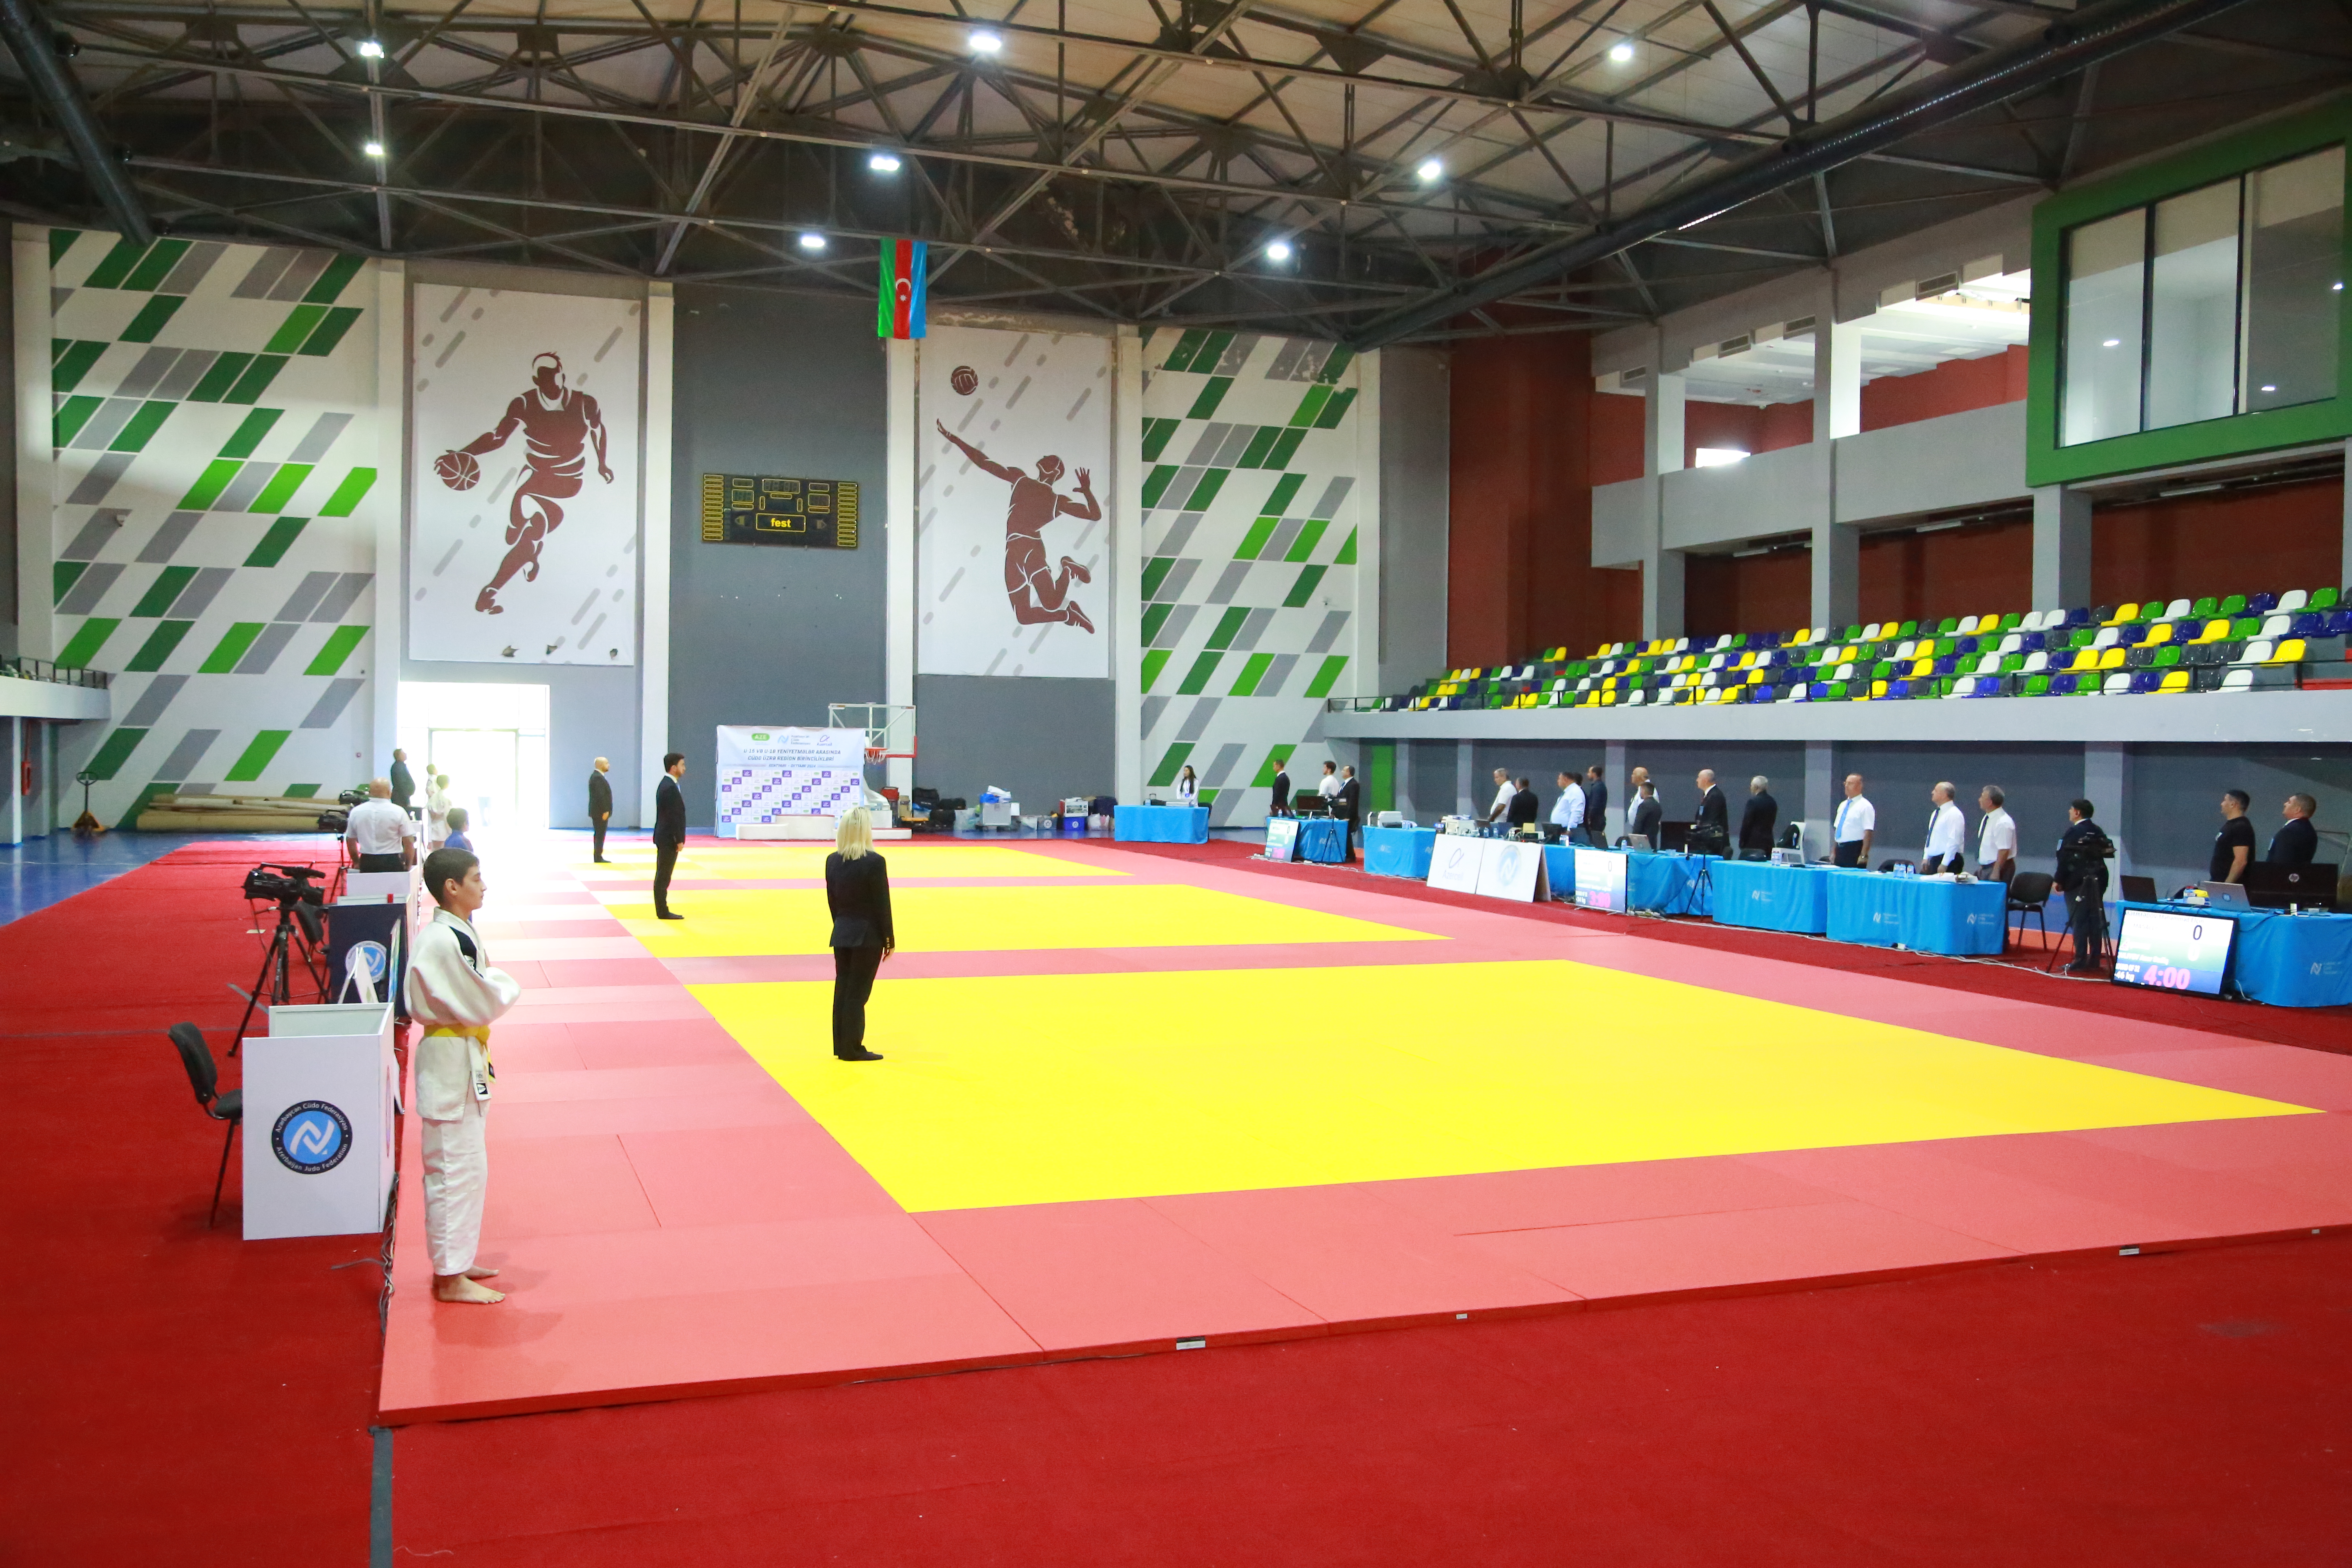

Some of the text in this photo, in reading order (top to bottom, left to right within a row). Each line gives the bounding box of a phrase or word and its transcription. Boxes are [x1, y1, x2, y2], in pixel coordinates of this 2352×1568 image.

[771, 518, 791, 528] fest
[1287, 826, 1290, 834] 0
[1608, 861, 1612, 872] 0
[1442, 869, 1463, 881] Azercell
[1589, 891, 1610, 908] 3:00
[2193, 925, 2203, 940] 0
[2125, 971, 2135, 982] kg
[2143, 965, 2190, 989] 4:00
[321, 1104, 348, 1130] Federasiyası
[276, 1147, 302, 1170] Azerbaijan
[322, 1144, 348, 1167] Federation
